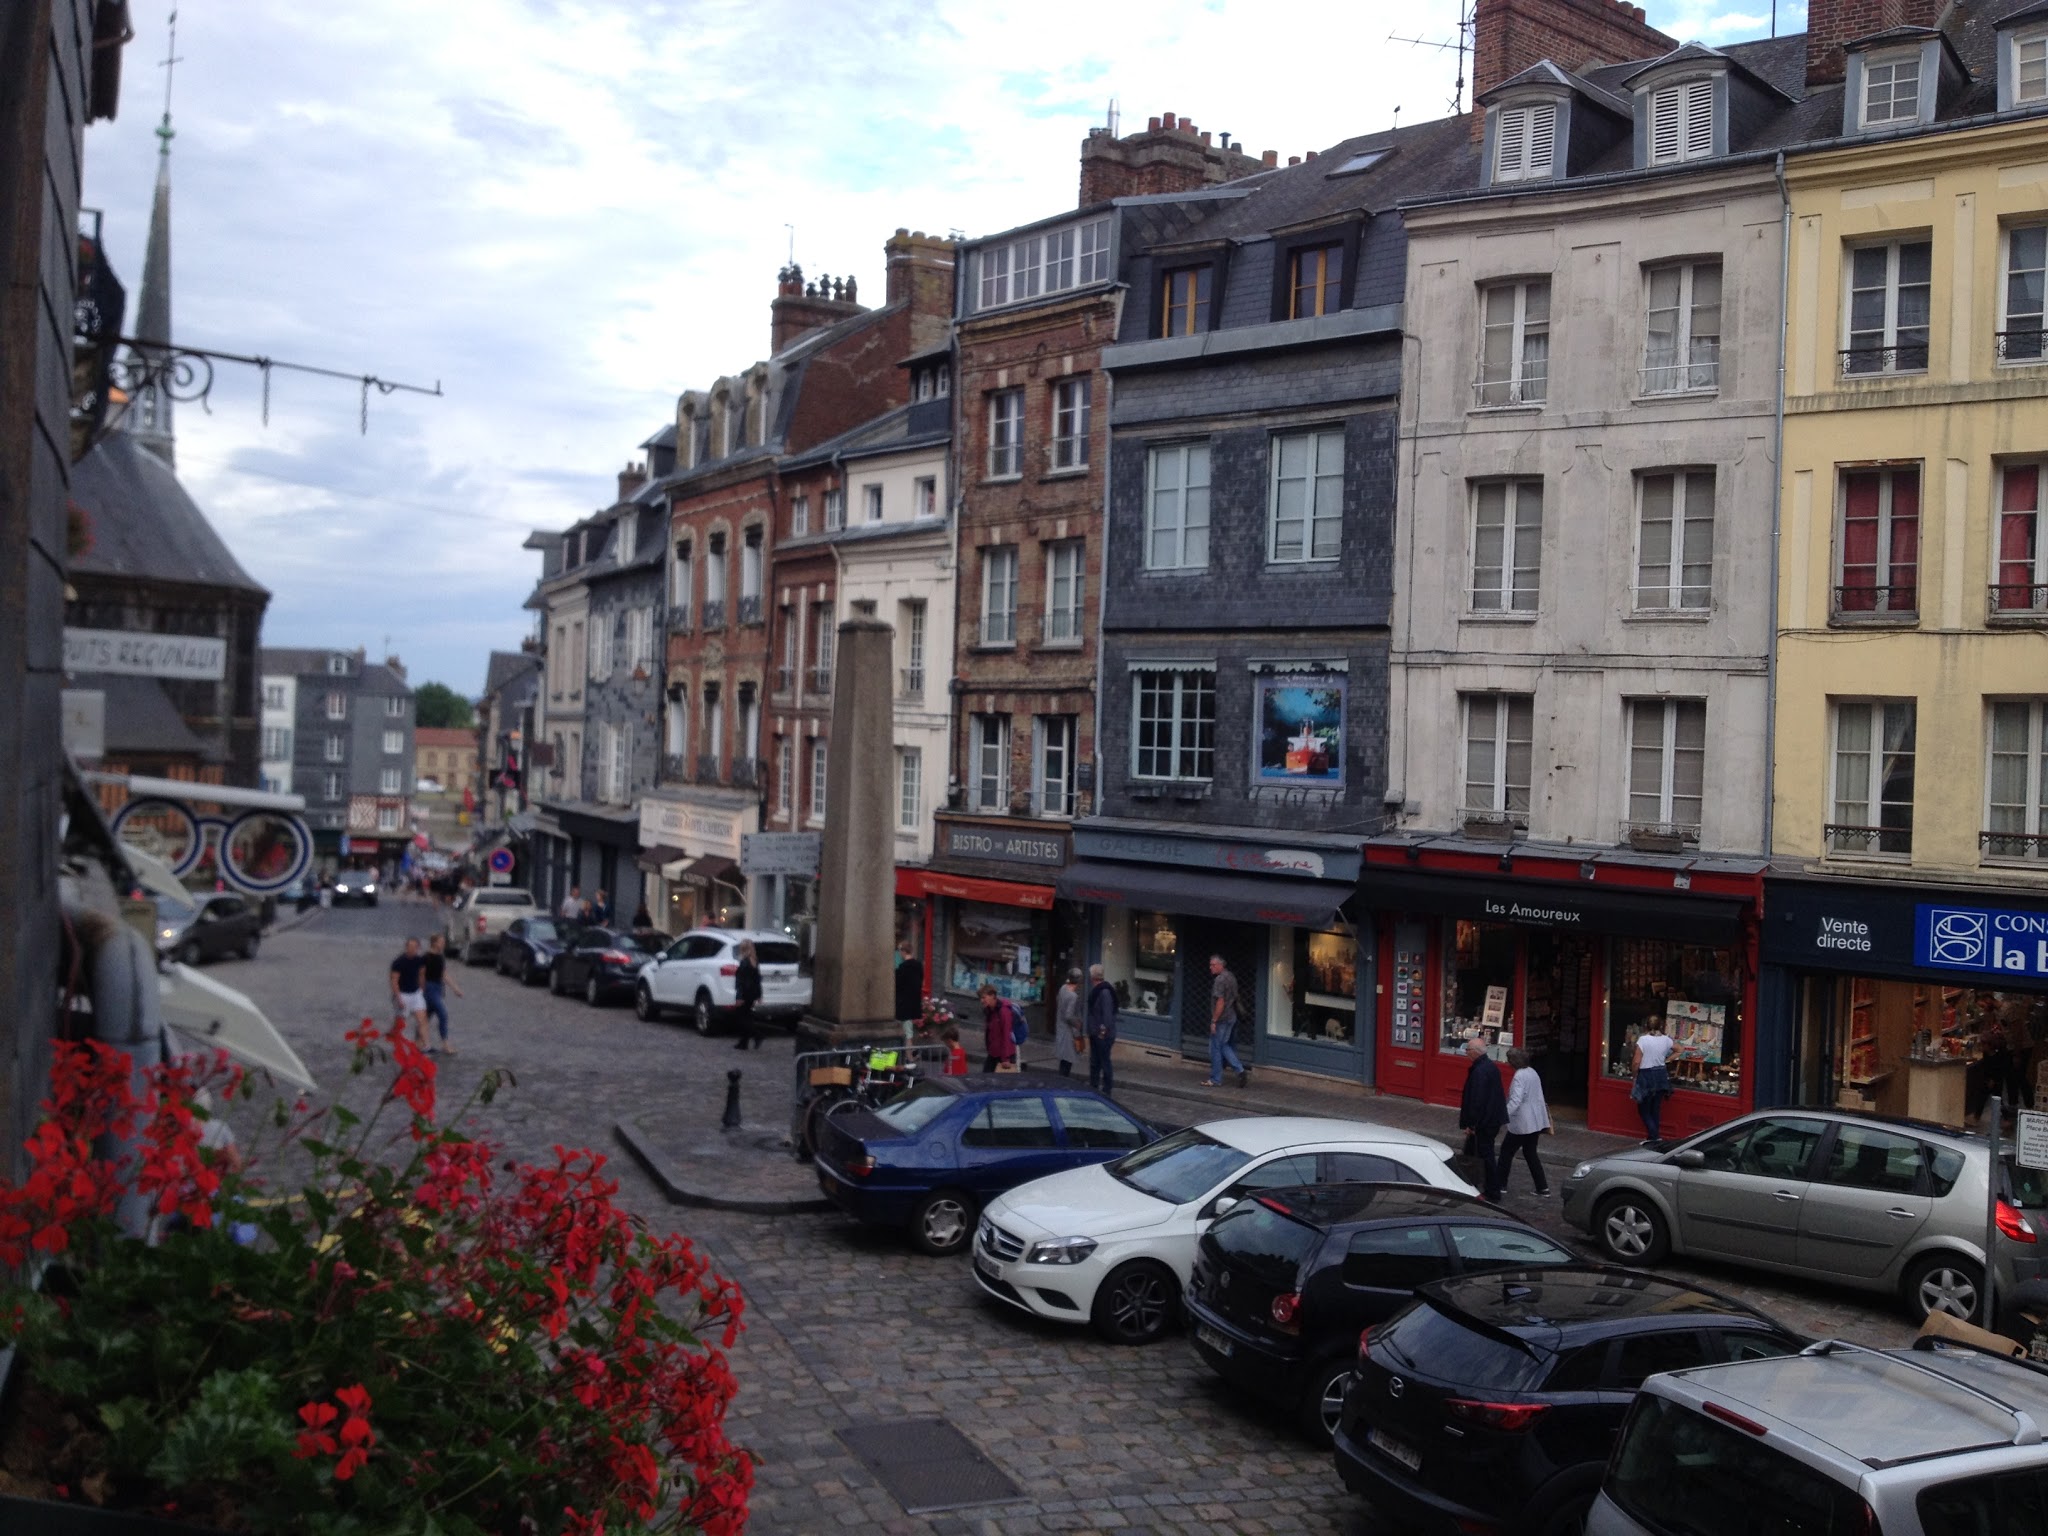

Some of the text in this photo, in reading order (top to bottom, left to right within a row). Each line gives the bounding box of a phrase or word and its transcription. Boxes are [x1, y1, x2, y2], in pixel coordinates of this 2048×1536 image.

[952, 834, 993, 852] BISTRO
[1006, 839, 1059, 859] ARTISTES
[1485, 899, 1506, 914] Les
[1509, 902, 1581, 922] Amoureux
[1821, 916, 1869, 935] Vente
[1994, 914, 2048, 934] CON
[1816, 933, 1872, 952] directe
[1993, 936, 2026, 970] la
